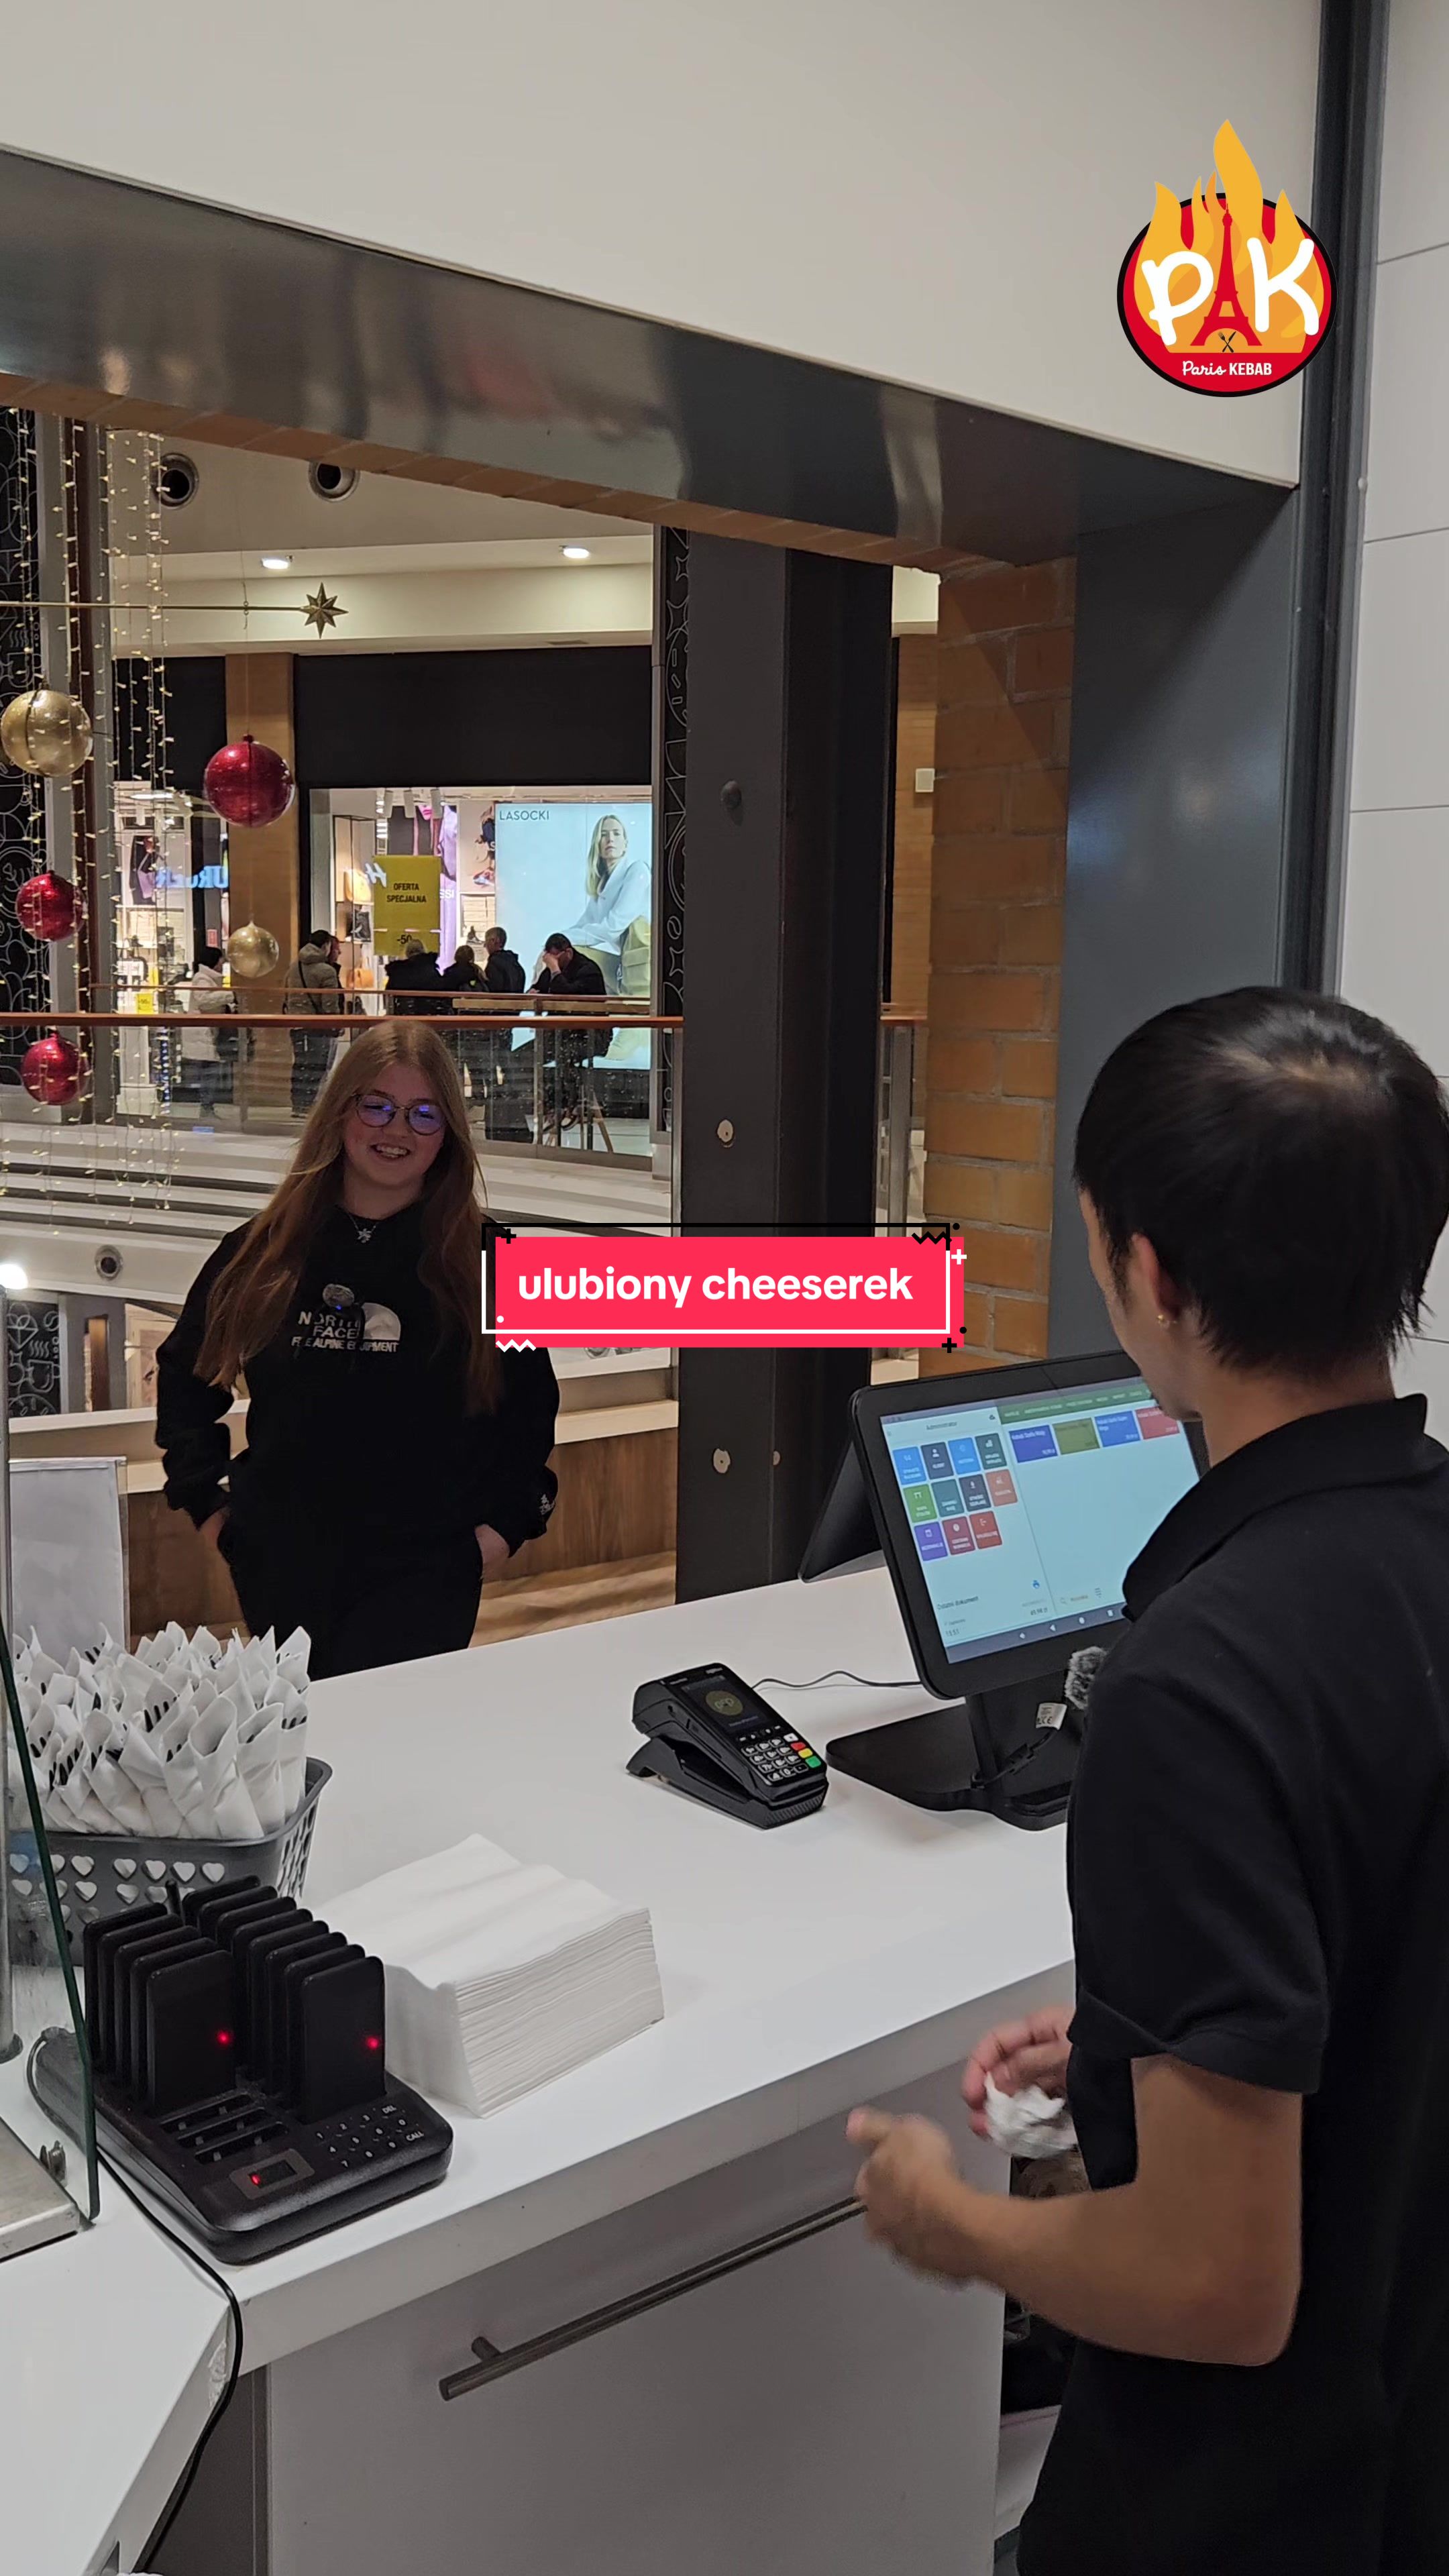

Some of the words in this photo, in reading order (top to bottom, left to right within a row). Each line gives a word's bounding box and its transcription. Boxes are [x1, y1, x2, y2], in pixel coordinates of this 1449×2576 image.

[499, 810, 549, 820] LASOCKI
[393, 883, 419, 891] OFERTA
[386, 895, 427, 903] SPECJALNA
[313, 1325, 358, 1339] FACE
[346, 1340, 400, 1352] EUIPMENT
[382, 2105, 397, 2114] DEL
[405, 2131, 425, 2141] CALL
